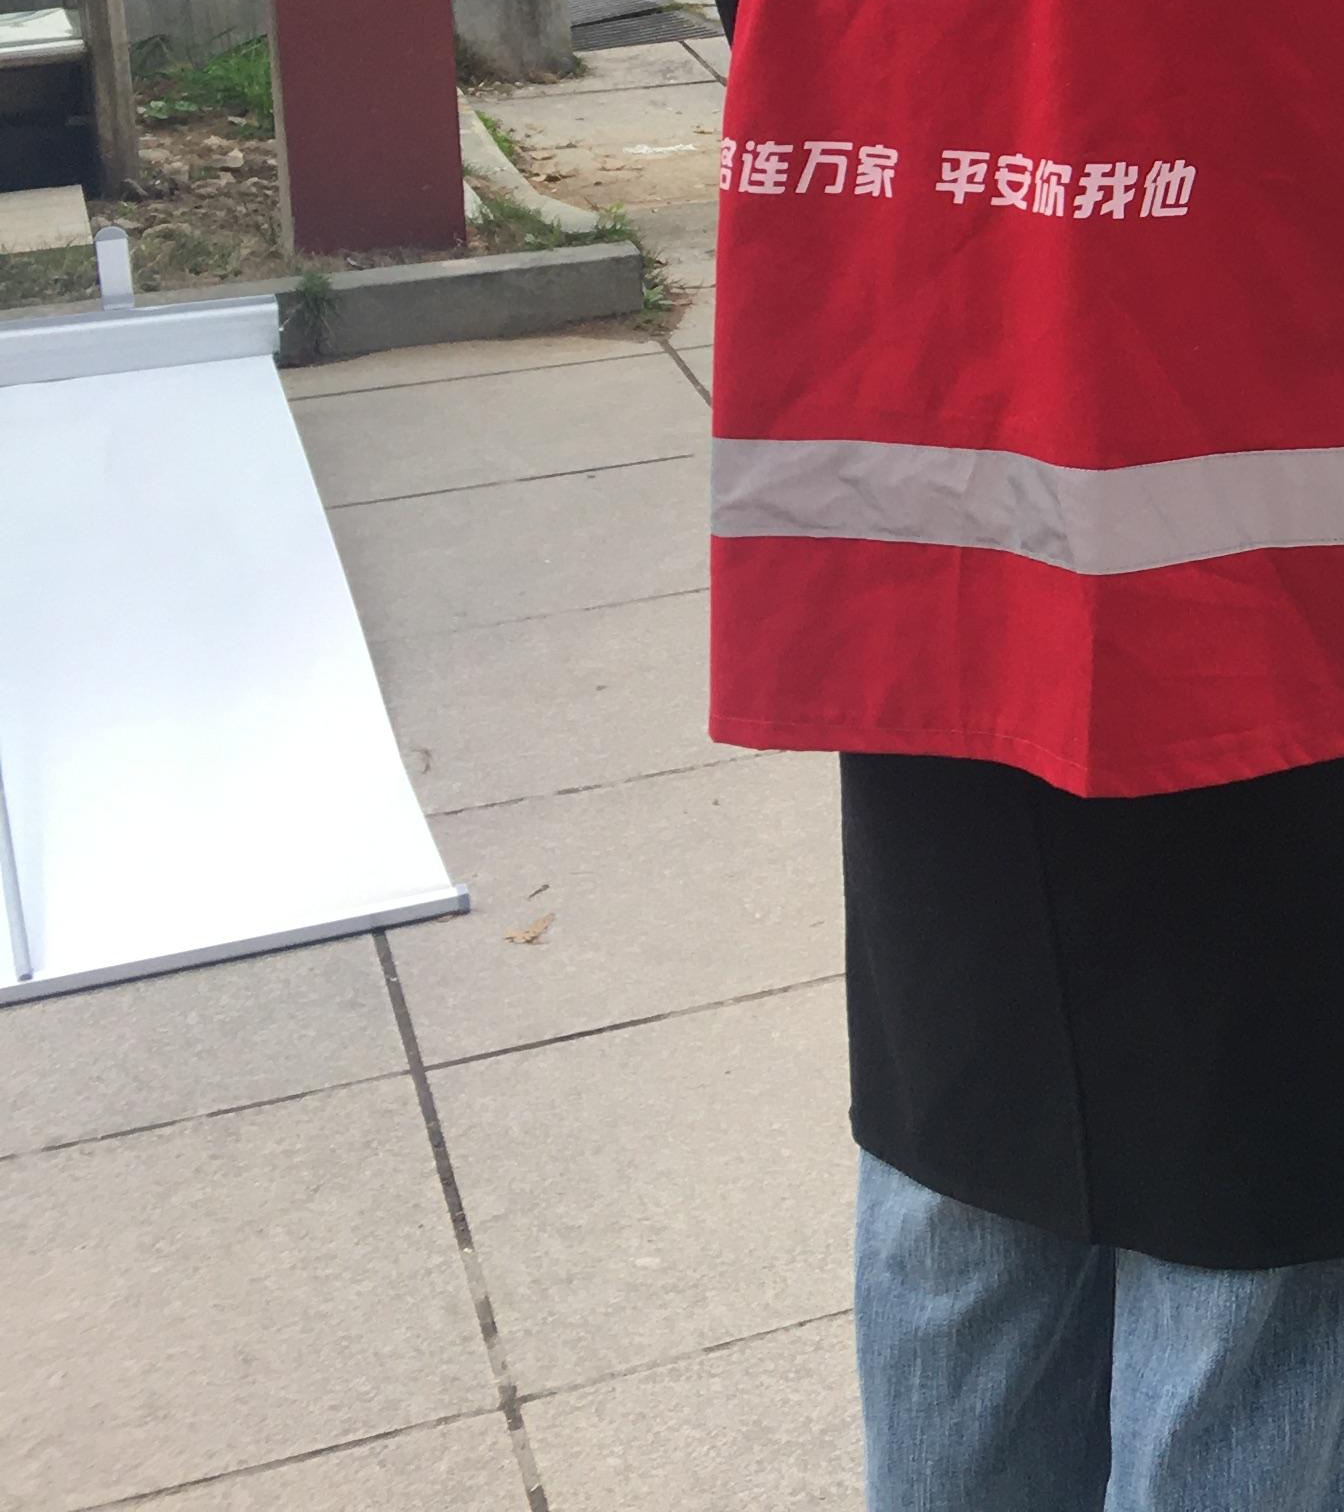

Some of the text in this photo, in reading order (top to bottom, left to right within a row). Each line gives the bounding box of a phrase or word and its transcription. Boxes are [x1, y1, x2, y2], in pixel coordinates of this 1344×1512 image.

[935, 149, 1197, 220] 平安你我他
